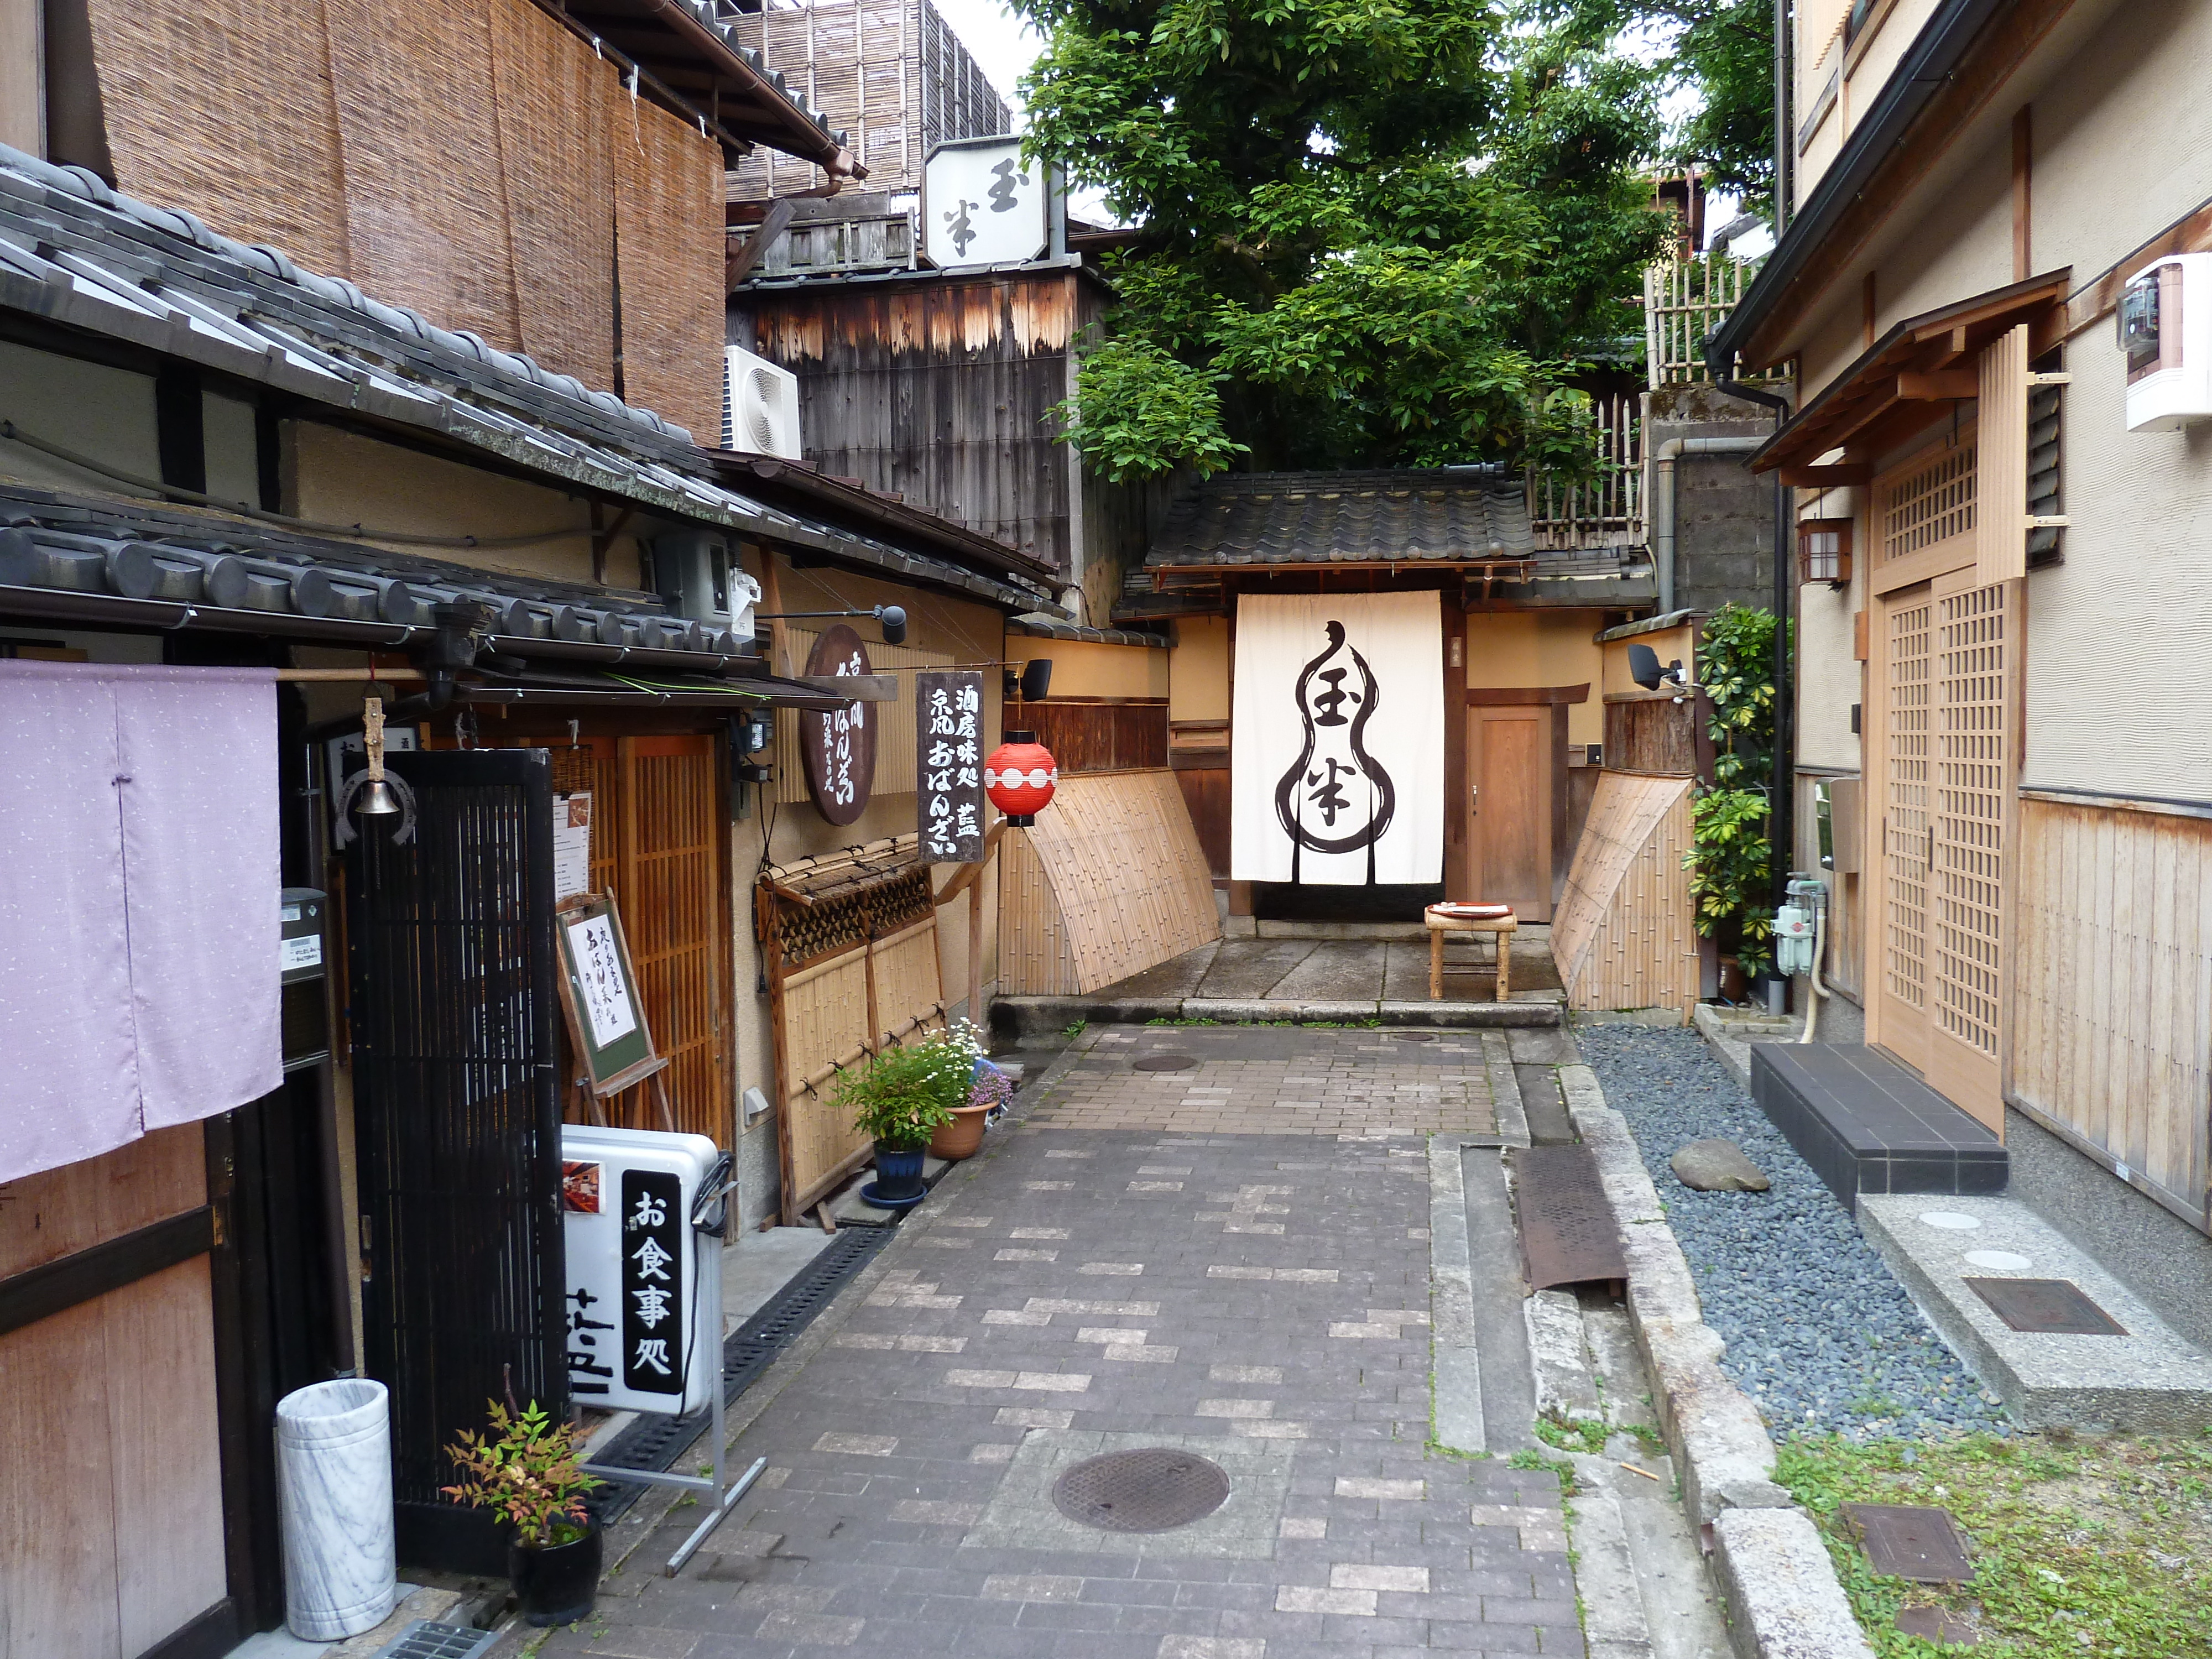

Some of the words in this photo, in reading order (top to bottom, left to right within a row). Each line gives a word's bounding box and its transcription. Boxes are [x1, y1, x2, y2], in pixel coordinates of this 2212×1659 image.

[943, 158, 1030, 258] 玉半
[956, 685, 978, 788] 酒房味処
[1308, 667, 1361, 827] 玉半
[956, 803, 980, 838] 藍
[631, 1191, 673, 1375] お食事処
